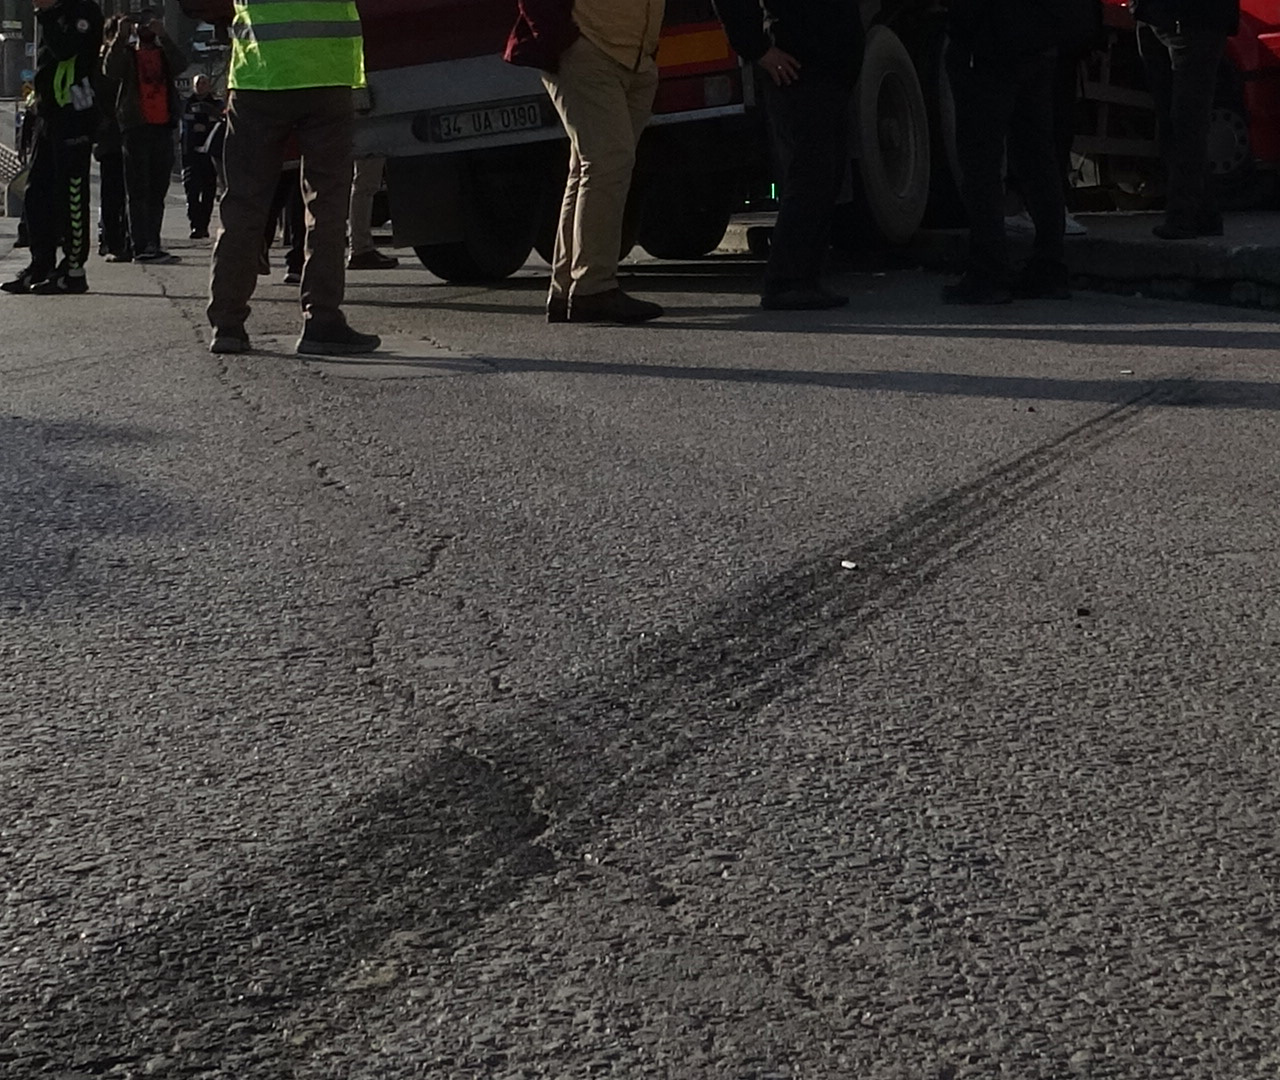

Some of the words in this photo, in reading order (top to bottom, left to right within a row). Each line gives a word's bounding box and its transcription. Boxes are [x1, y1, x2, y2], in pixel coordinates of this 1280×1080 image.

[441, 117, 461, 136] 34
[471, 111, 493, 132] UA
[501, 105, 537, 128] 0190
